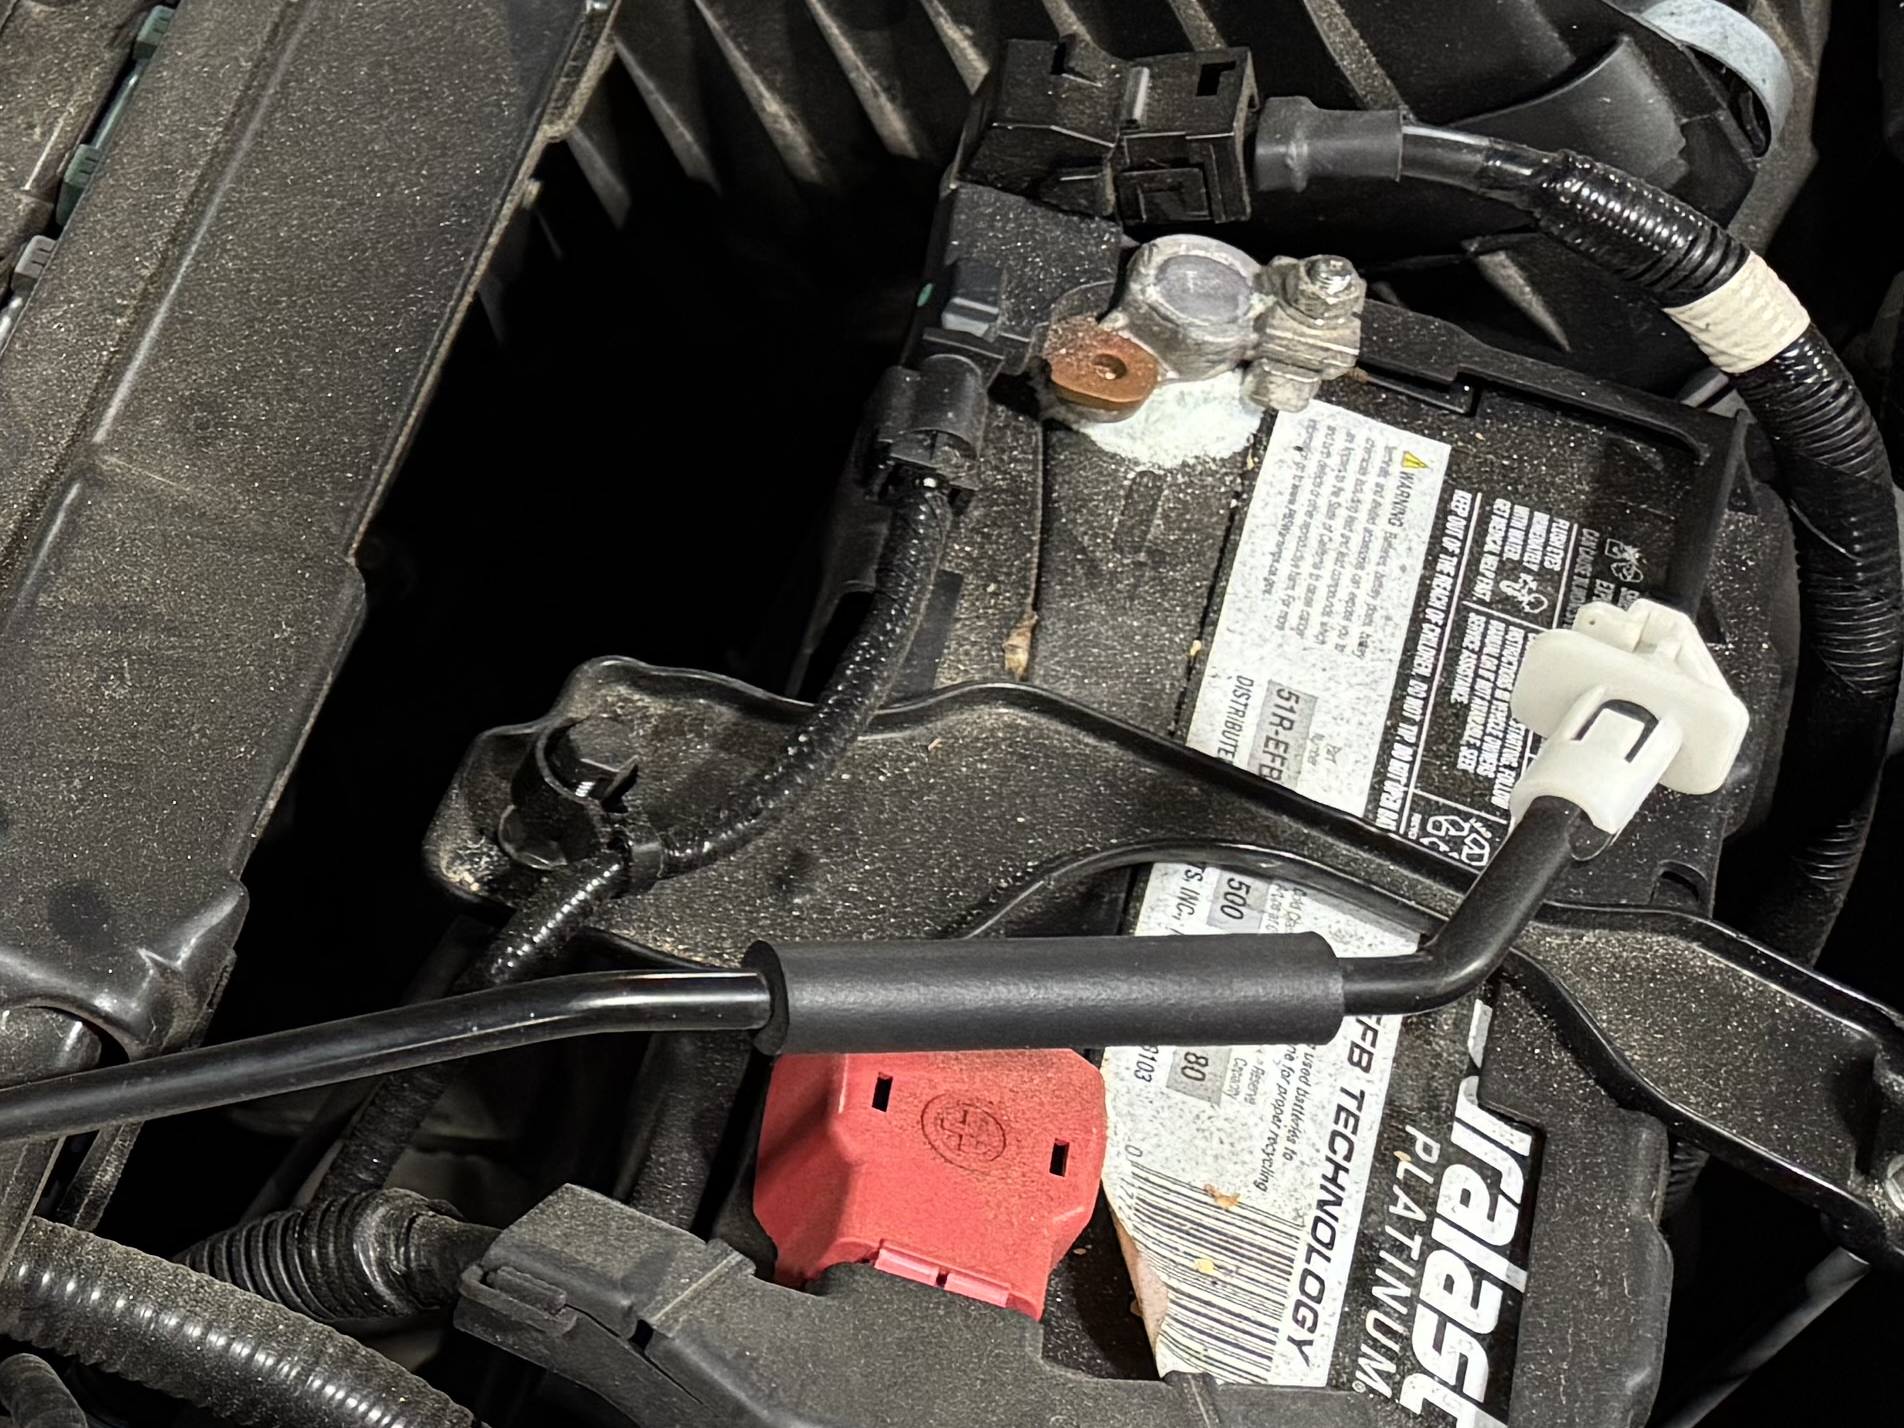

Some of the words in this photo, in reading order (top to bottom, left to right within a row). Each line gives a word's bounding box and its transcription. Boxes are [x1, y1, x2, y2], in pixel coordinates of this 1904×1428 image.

[1387, 469, 1415, 528] WARNING
[1448, 488, 1471, 516] KEEP
[1443, 514, 1465, 537] OUT
[1439, 536, 1460, 553] OF
[1434, 553, 1456, 575] THE
[1426, 572, 1451, 609] REACH
[1422, 606, 1443, 625] OF
[1215, 674, 1254, 765] DISTRIBUTE
[1256, 686, 1301, 782] 51R-EFB
[1218, 876, 1251, 921] 500
[1177, 1050, 1210, 1083] 80
[1290, 1085, 1367, 1367] TECHNOLOGY
